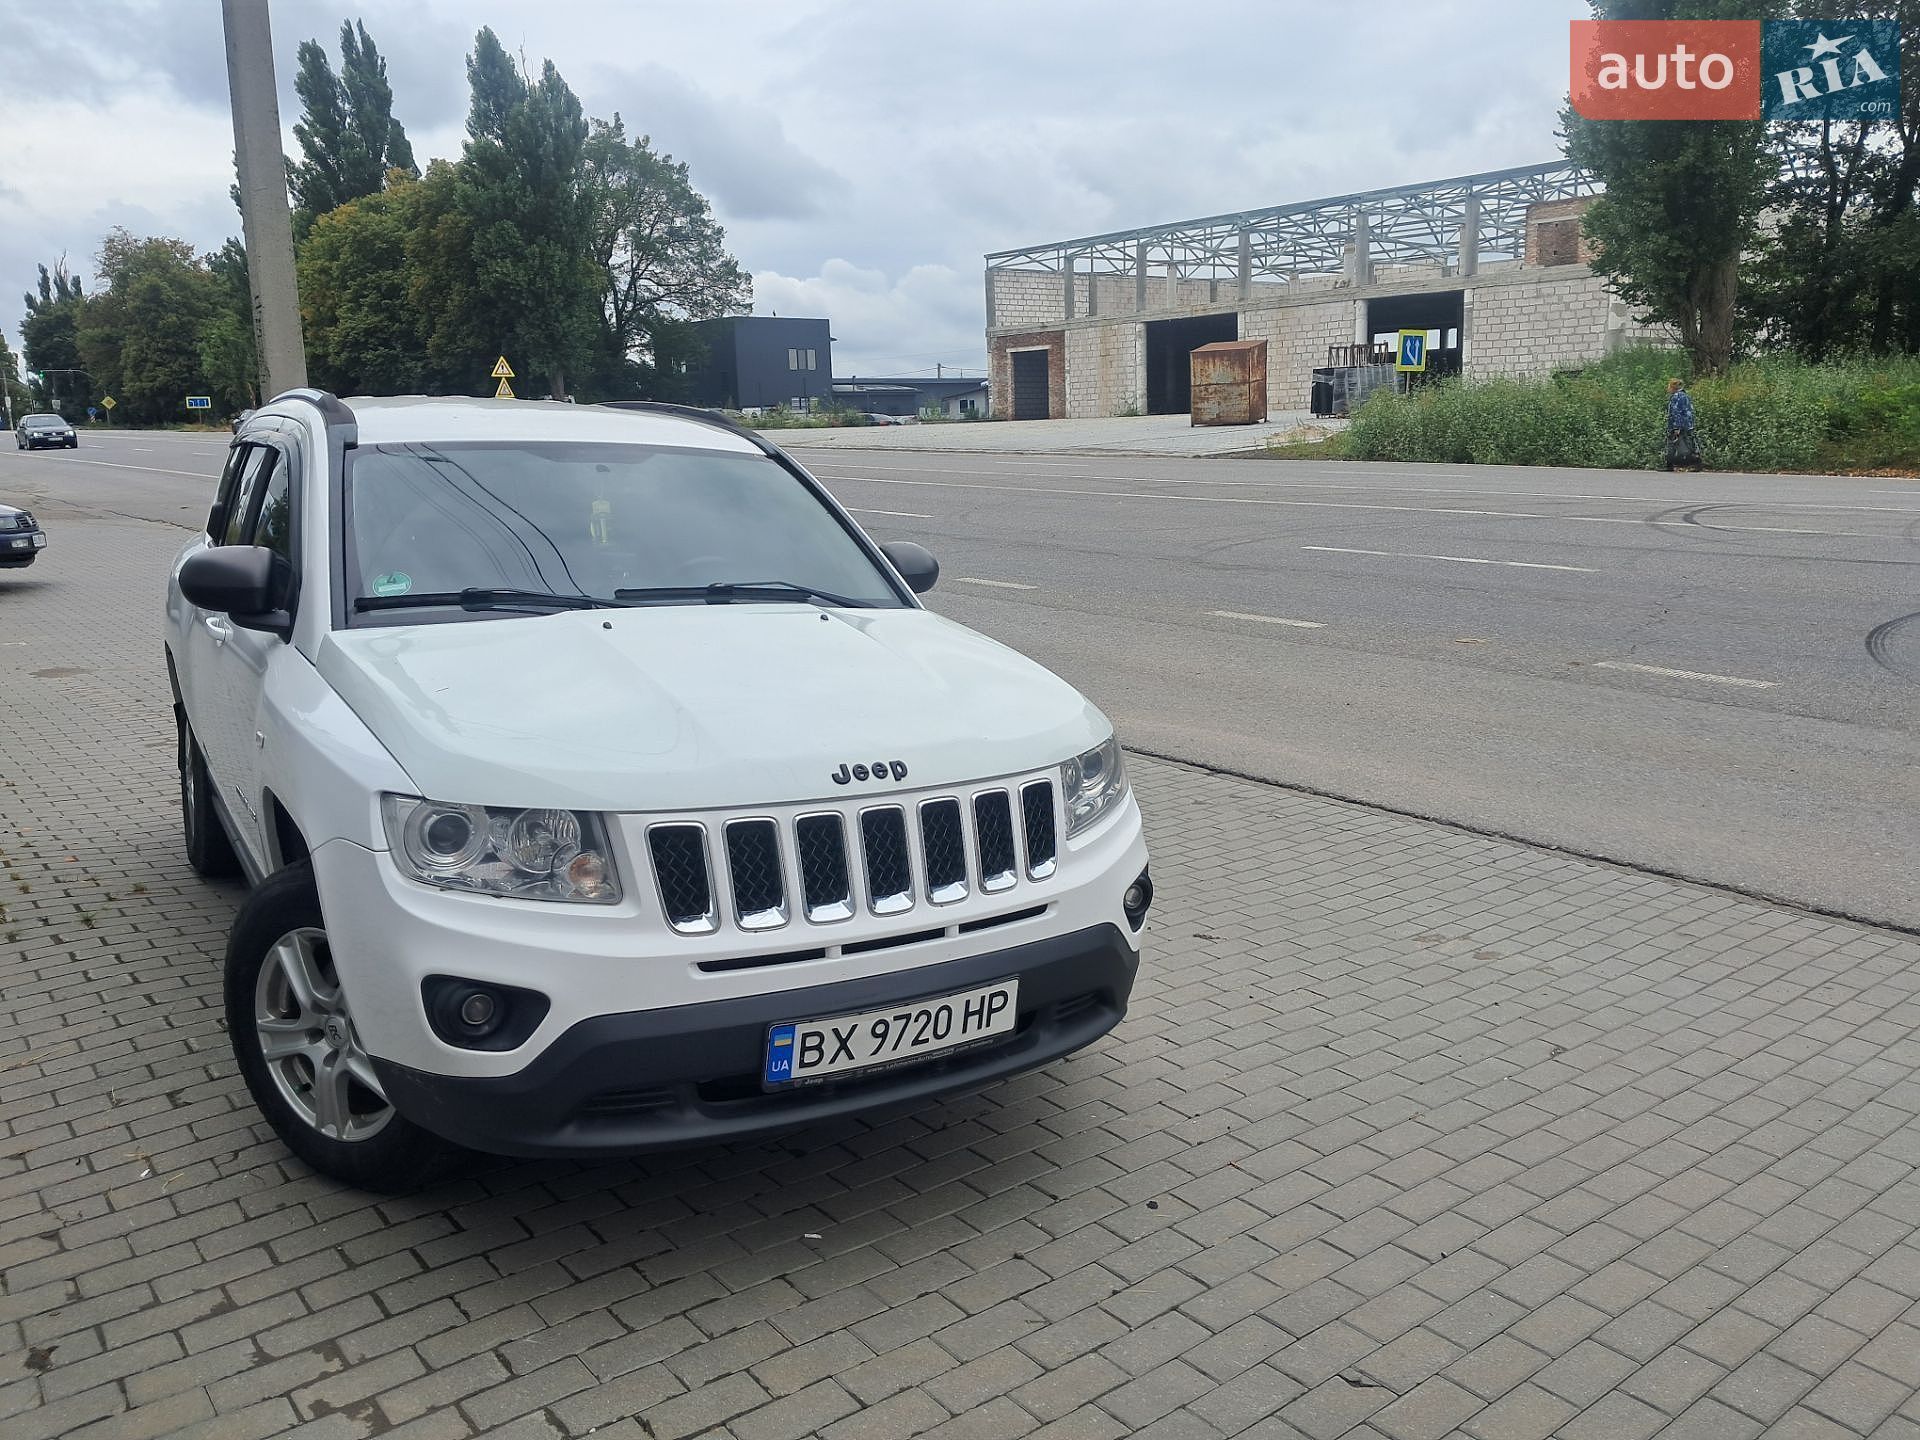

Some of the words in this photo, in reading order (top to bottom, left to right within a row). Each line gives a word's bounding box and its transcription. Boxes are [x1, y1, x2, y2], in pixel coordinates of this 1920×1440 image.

[831, 760, 908, 785] Jeep
[798, 1024, 858, 1069] BX
[870, 1005, 953, 1056] 9720
[962, 990, 1009, 1034] HP
[772, 1060, 789, 1072] UA
